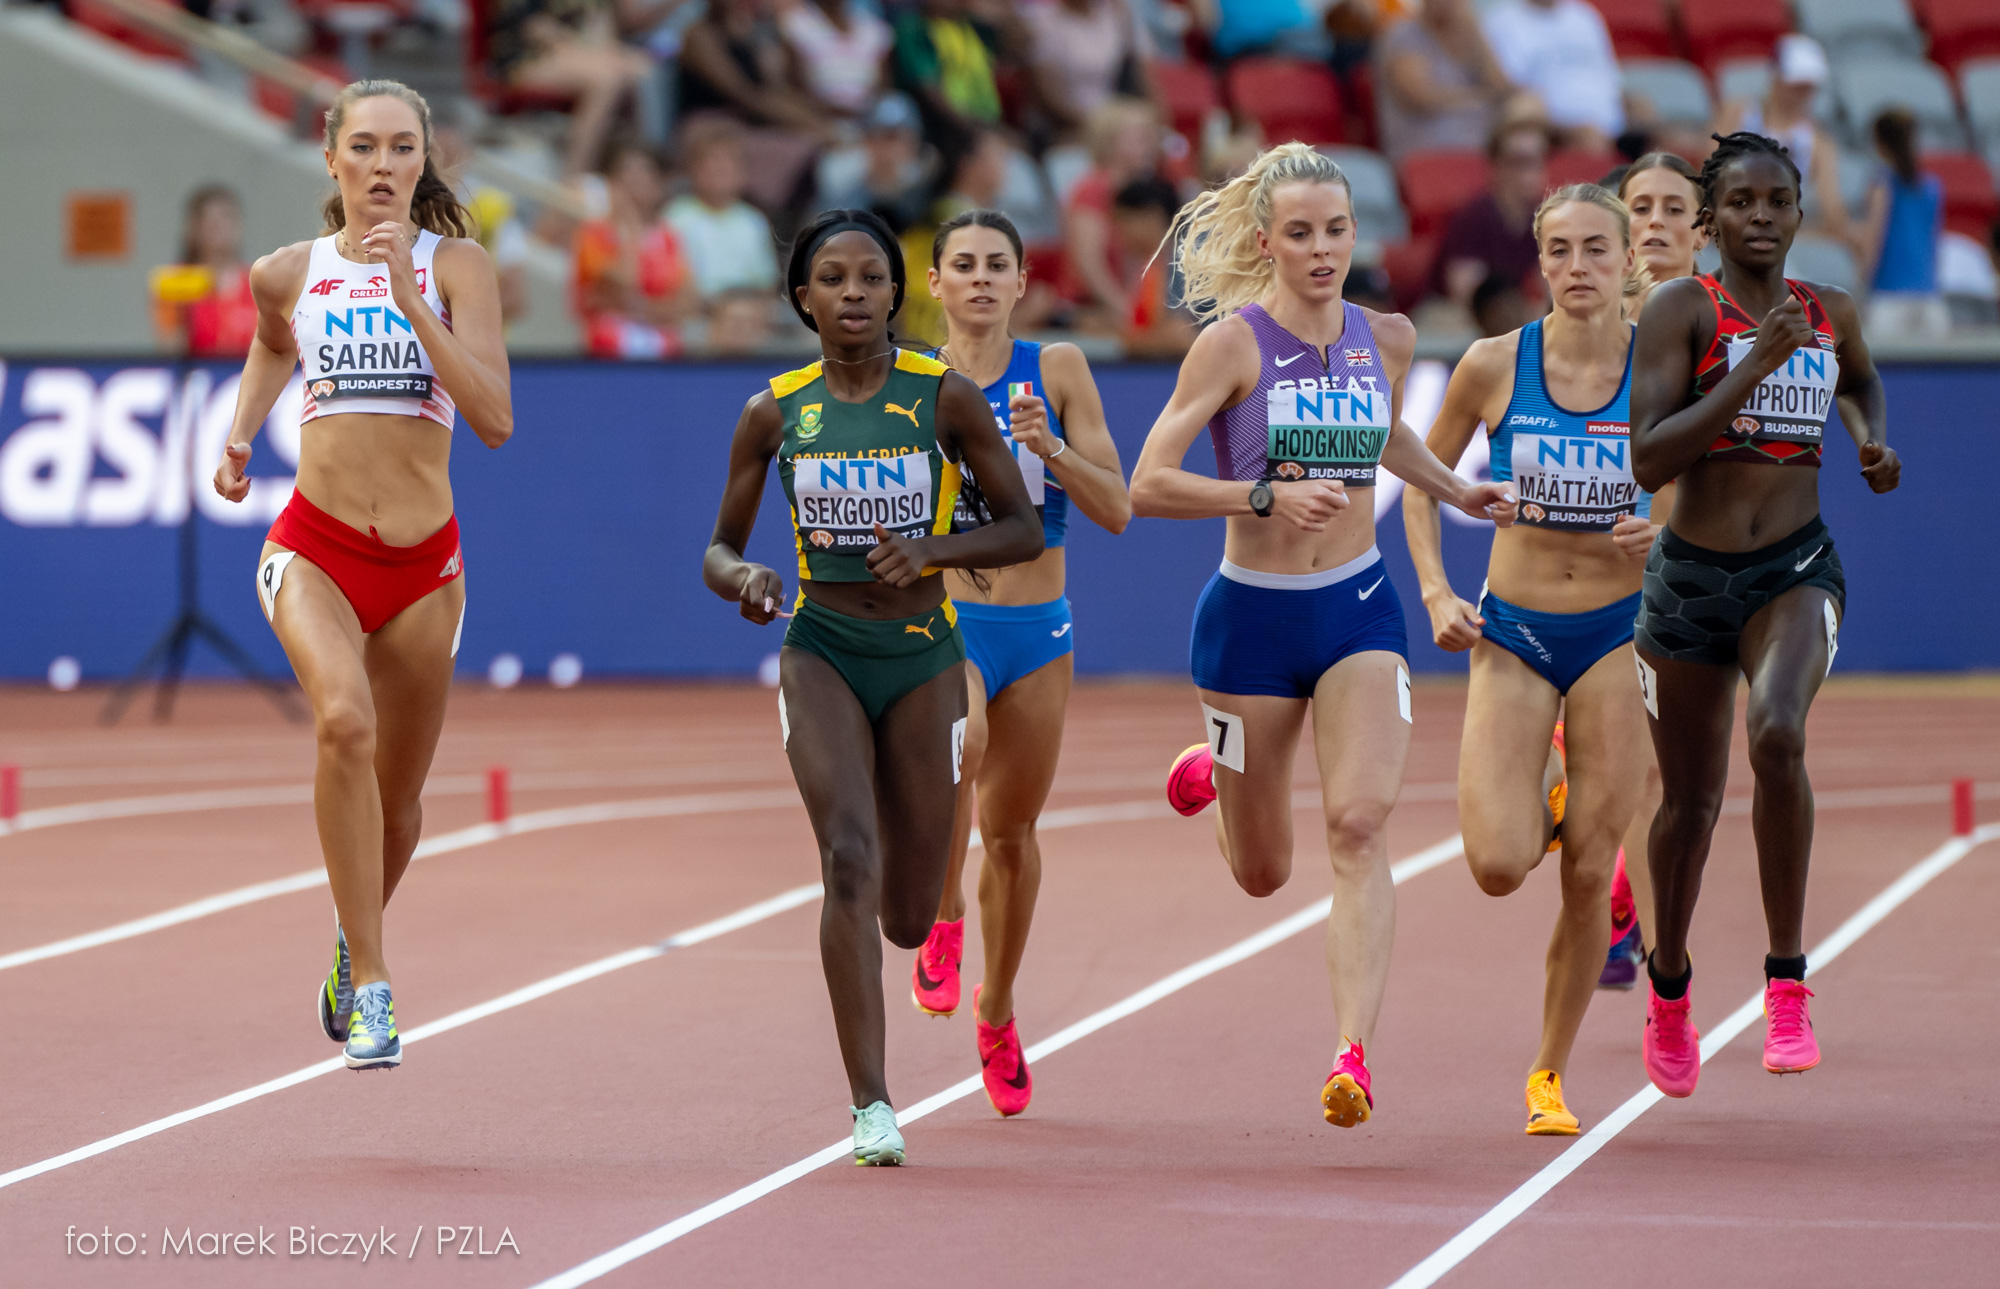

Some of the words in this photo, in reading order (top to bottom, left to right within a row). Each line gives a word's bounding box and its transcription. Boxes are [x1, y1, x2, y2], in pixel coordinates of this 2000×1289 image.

[351, 289, 386, 298] ORLEN
[325, 306, 412, 338] NTN
[318, 341, 423, 373] SARNA
[1773, 350, 1825, 382] TN
[338, 379, 414, 391] BUDAPEST
[414, 381, 428, 391] 23
[1742, 382, 1832, 417] IPROTICH
[1296, 391, 1374, 423] NTN
[1510, 415, 1549, 427] CRAFT
[1274, 429, 1385, 459] HODGKINSON
[1537, 437, 1625, 472] NTN
[820, 457, 907, 491] NTN
[1519, 472, 1638, 506] MÄÄTTÄNEN
[803, 491, 924, 525] SEKGODISO
[1549, 510, 1618, 524] BUDAPEST
[263, 561, 275, 602] 9
[1516, 623, 1546, 655] CRAFT
[1212, 716, 1229, 757] 7
